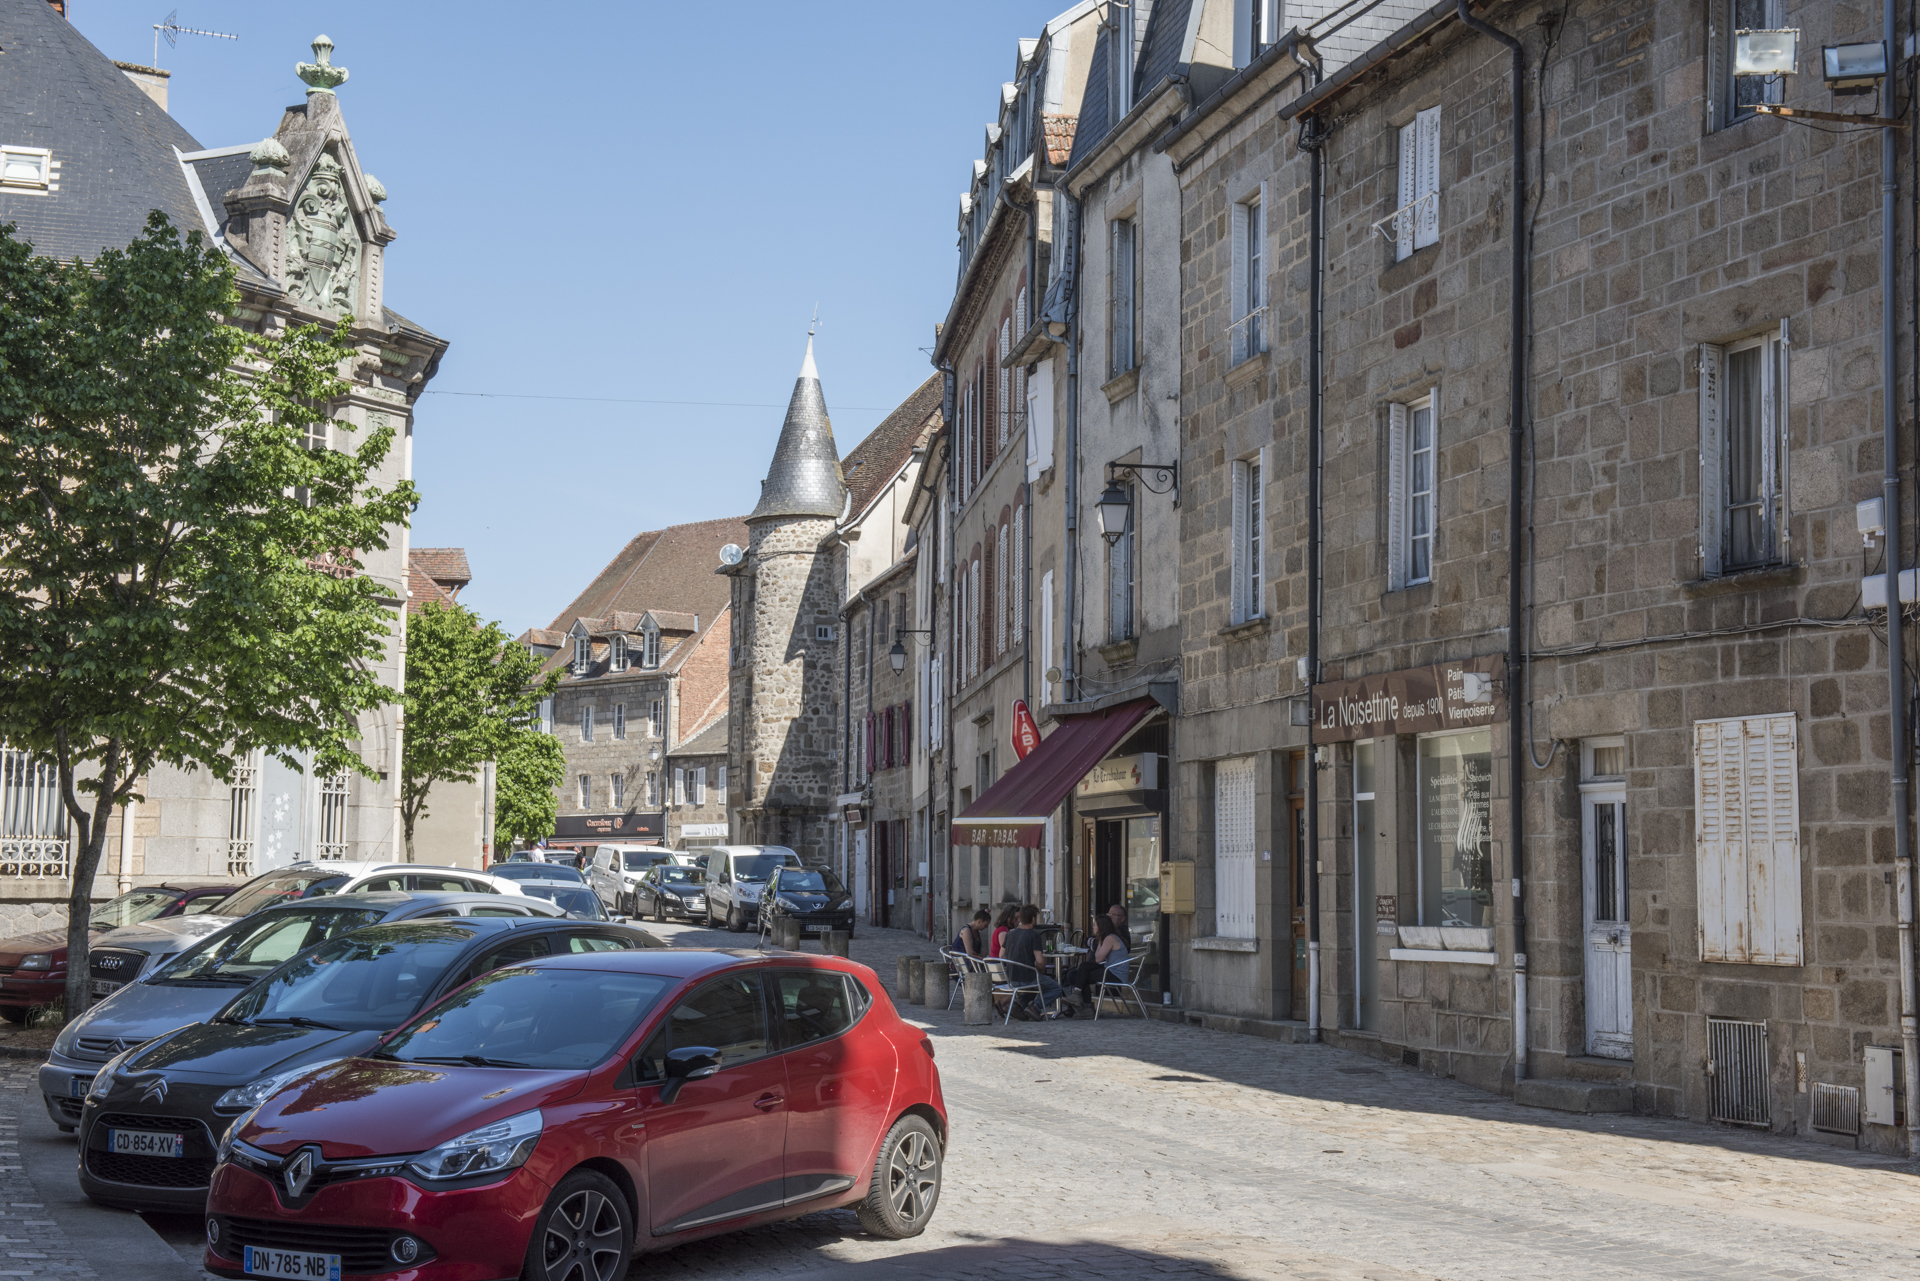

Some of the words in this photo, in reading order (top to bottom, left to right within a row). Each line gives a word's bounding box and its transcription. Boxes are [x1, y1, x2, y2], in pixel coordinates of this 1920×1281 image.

[1447, 668, 1464, 682] Pain
[1320, 699, 1336, 730] La
[1338, 690, 1399, 727] Noisettine
[1402, 700, 1425, 722] depuis
[1426, 696, 1444, 715] 1900
[1448, 702, 1496, 720] Viennoiserie
[1018, 710, 1034, 755] TABA
[1093, 768, 1100, 783] Le
[1100, 766, 1127, 783] Troubadour
[1430, 774, 1458, 789] Spécialités
[586, 818, 613, 827] Carrefour
[971, 829, 987, 844] BAR
[993, 828, 1018, 844] TABAC
[116, 1133, 174, 1154] CD-854-XV
[886, 1127, 904, 1160] NEXEN
[253, 1250, 326, 1277] DN-785-NB
